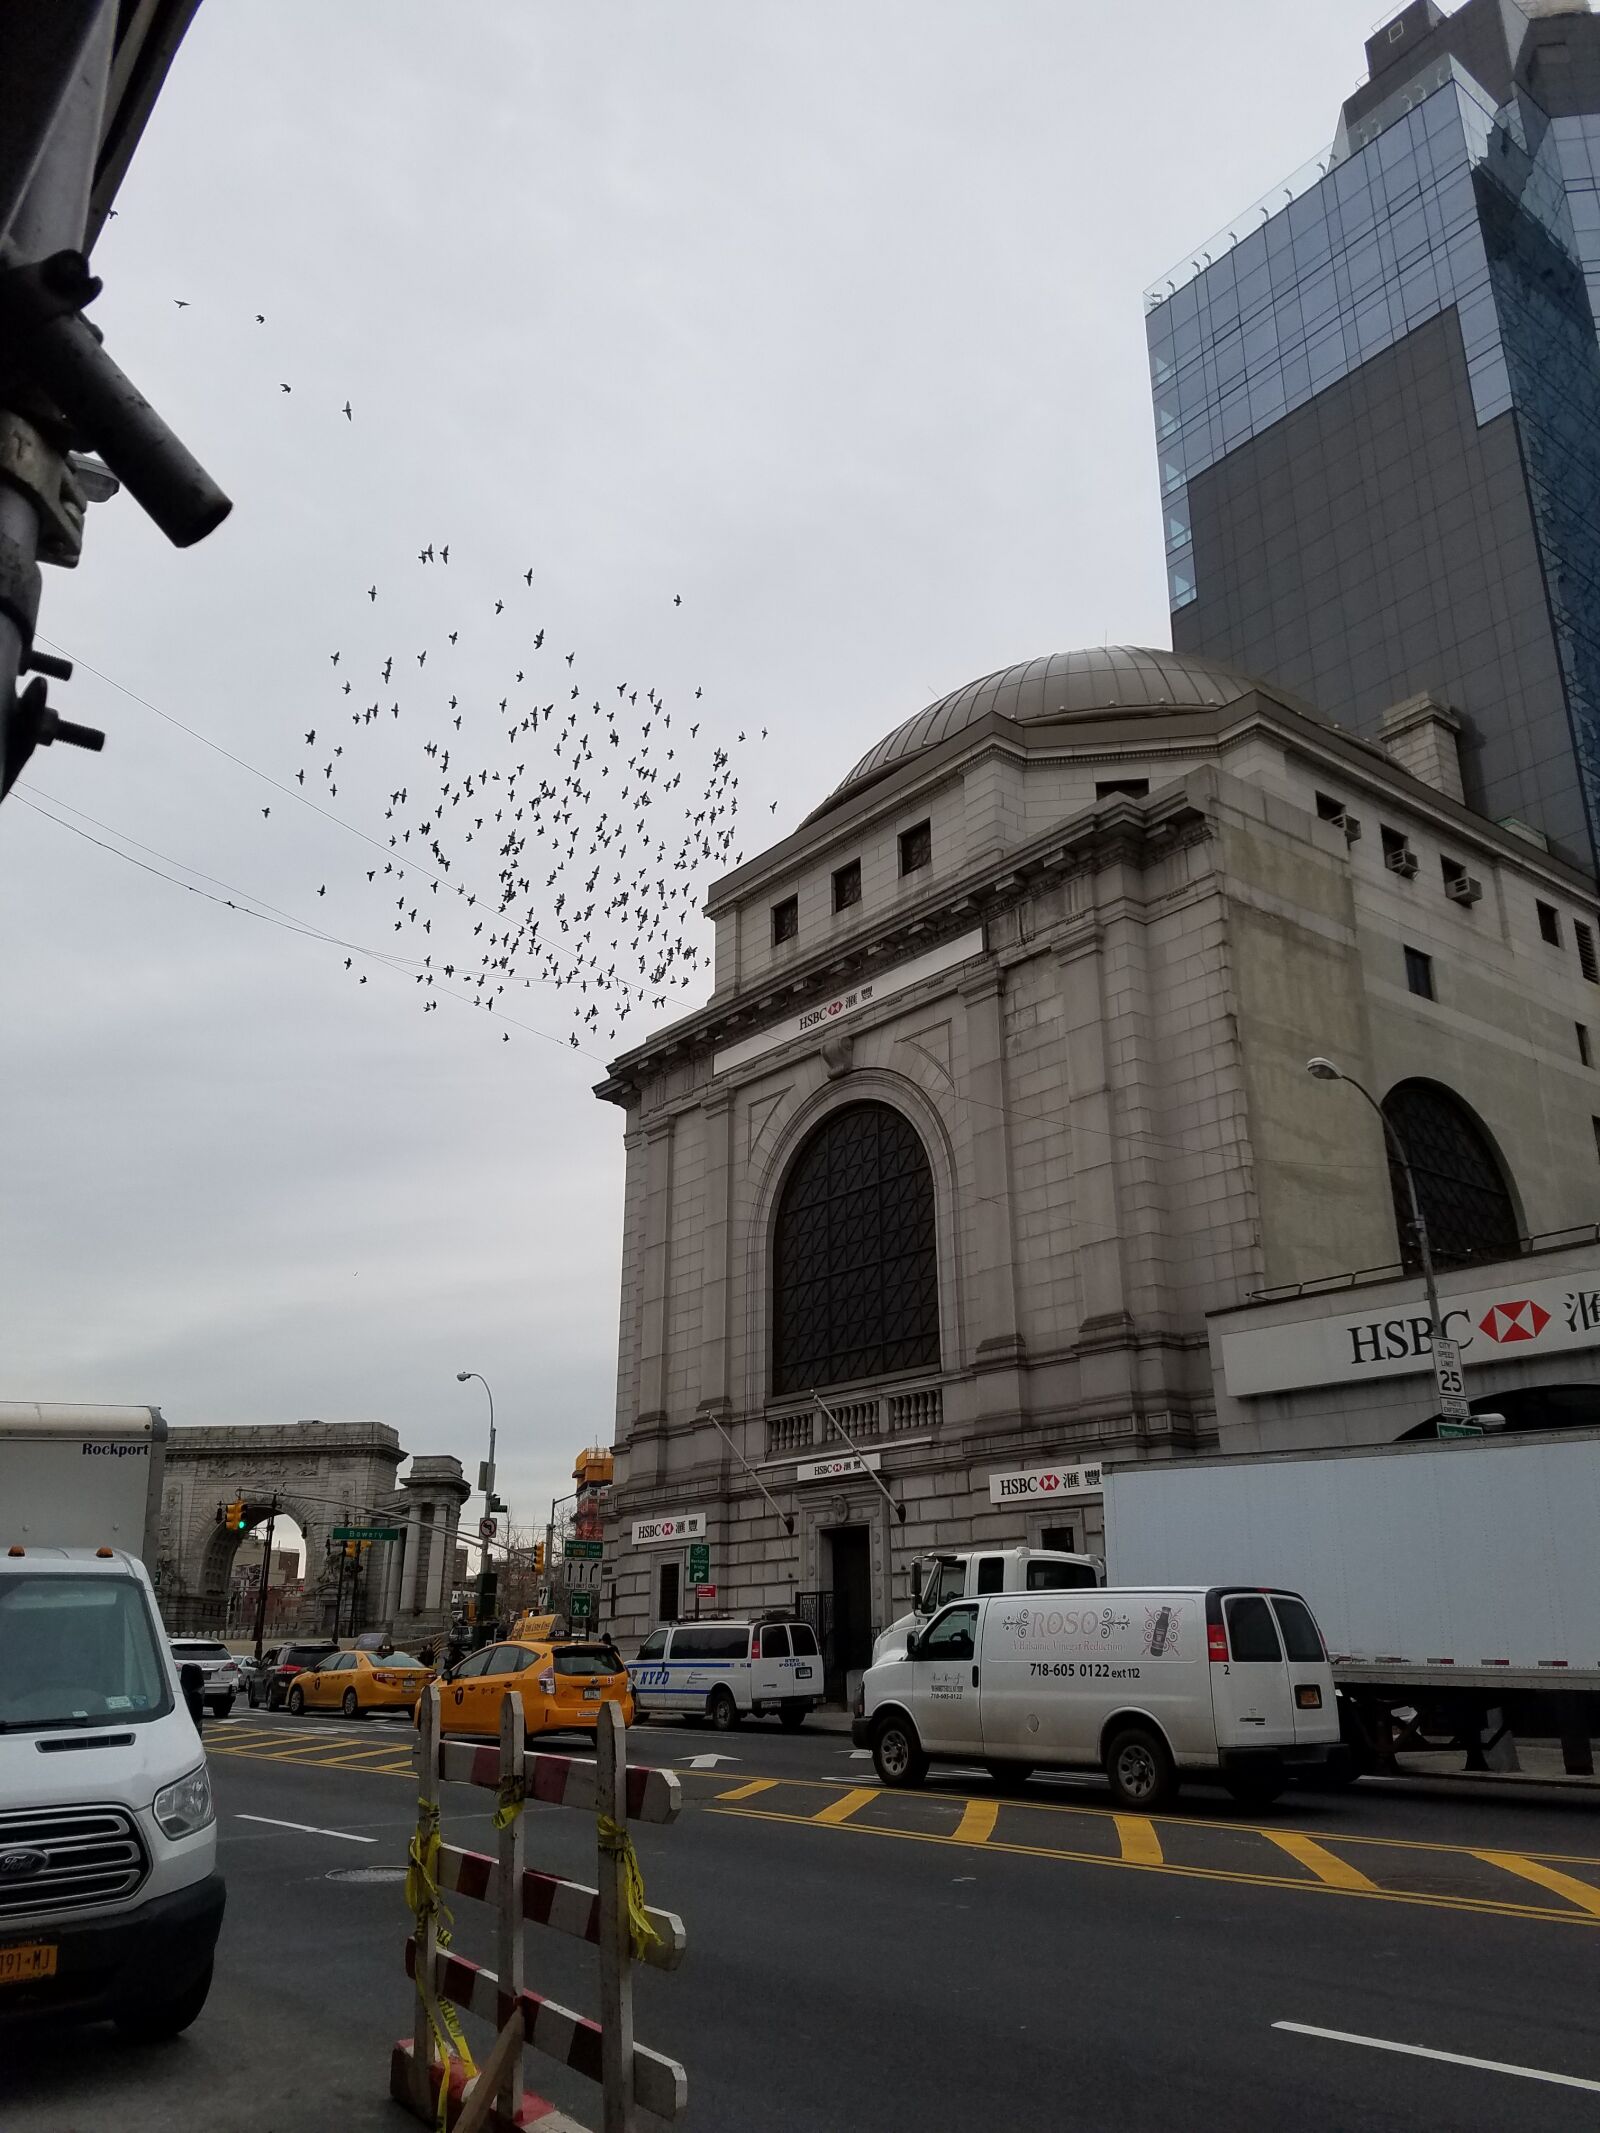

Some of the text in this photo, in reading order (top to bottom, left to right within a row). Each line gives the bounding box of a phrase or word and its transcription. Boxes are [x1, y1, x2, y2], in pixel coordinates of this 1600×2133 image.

[799, 1007, 827, 1031] HSBC
[1346, 1309, 1474, 1364] HSBC
[1438, 1350, 1455, 1358] SPEED
[1439, 1370, 1462, 1392] 25
[82, 1443, 149, 1457] Rockport
[814, 1464, 833, 1476] HSBC
[1000, 1476, 1038, 1496] HSBC
[349, 1530, 384, 1539] Bowery
[638, 1523, 662, 1539] HSBC
[1031, 1611, 1099, 1638] ROSO
[1083, 1640, 1122, 1651] Reduction
[1030, 1663, 1075, 1677] 718-605
[1080, 1664, 1110, 1677] 0122
[1224, 1664, 1231, 1675] 2
[639, 1671, 670, 1685] NYPD
[2, 1854, 36, 1872] Ford
